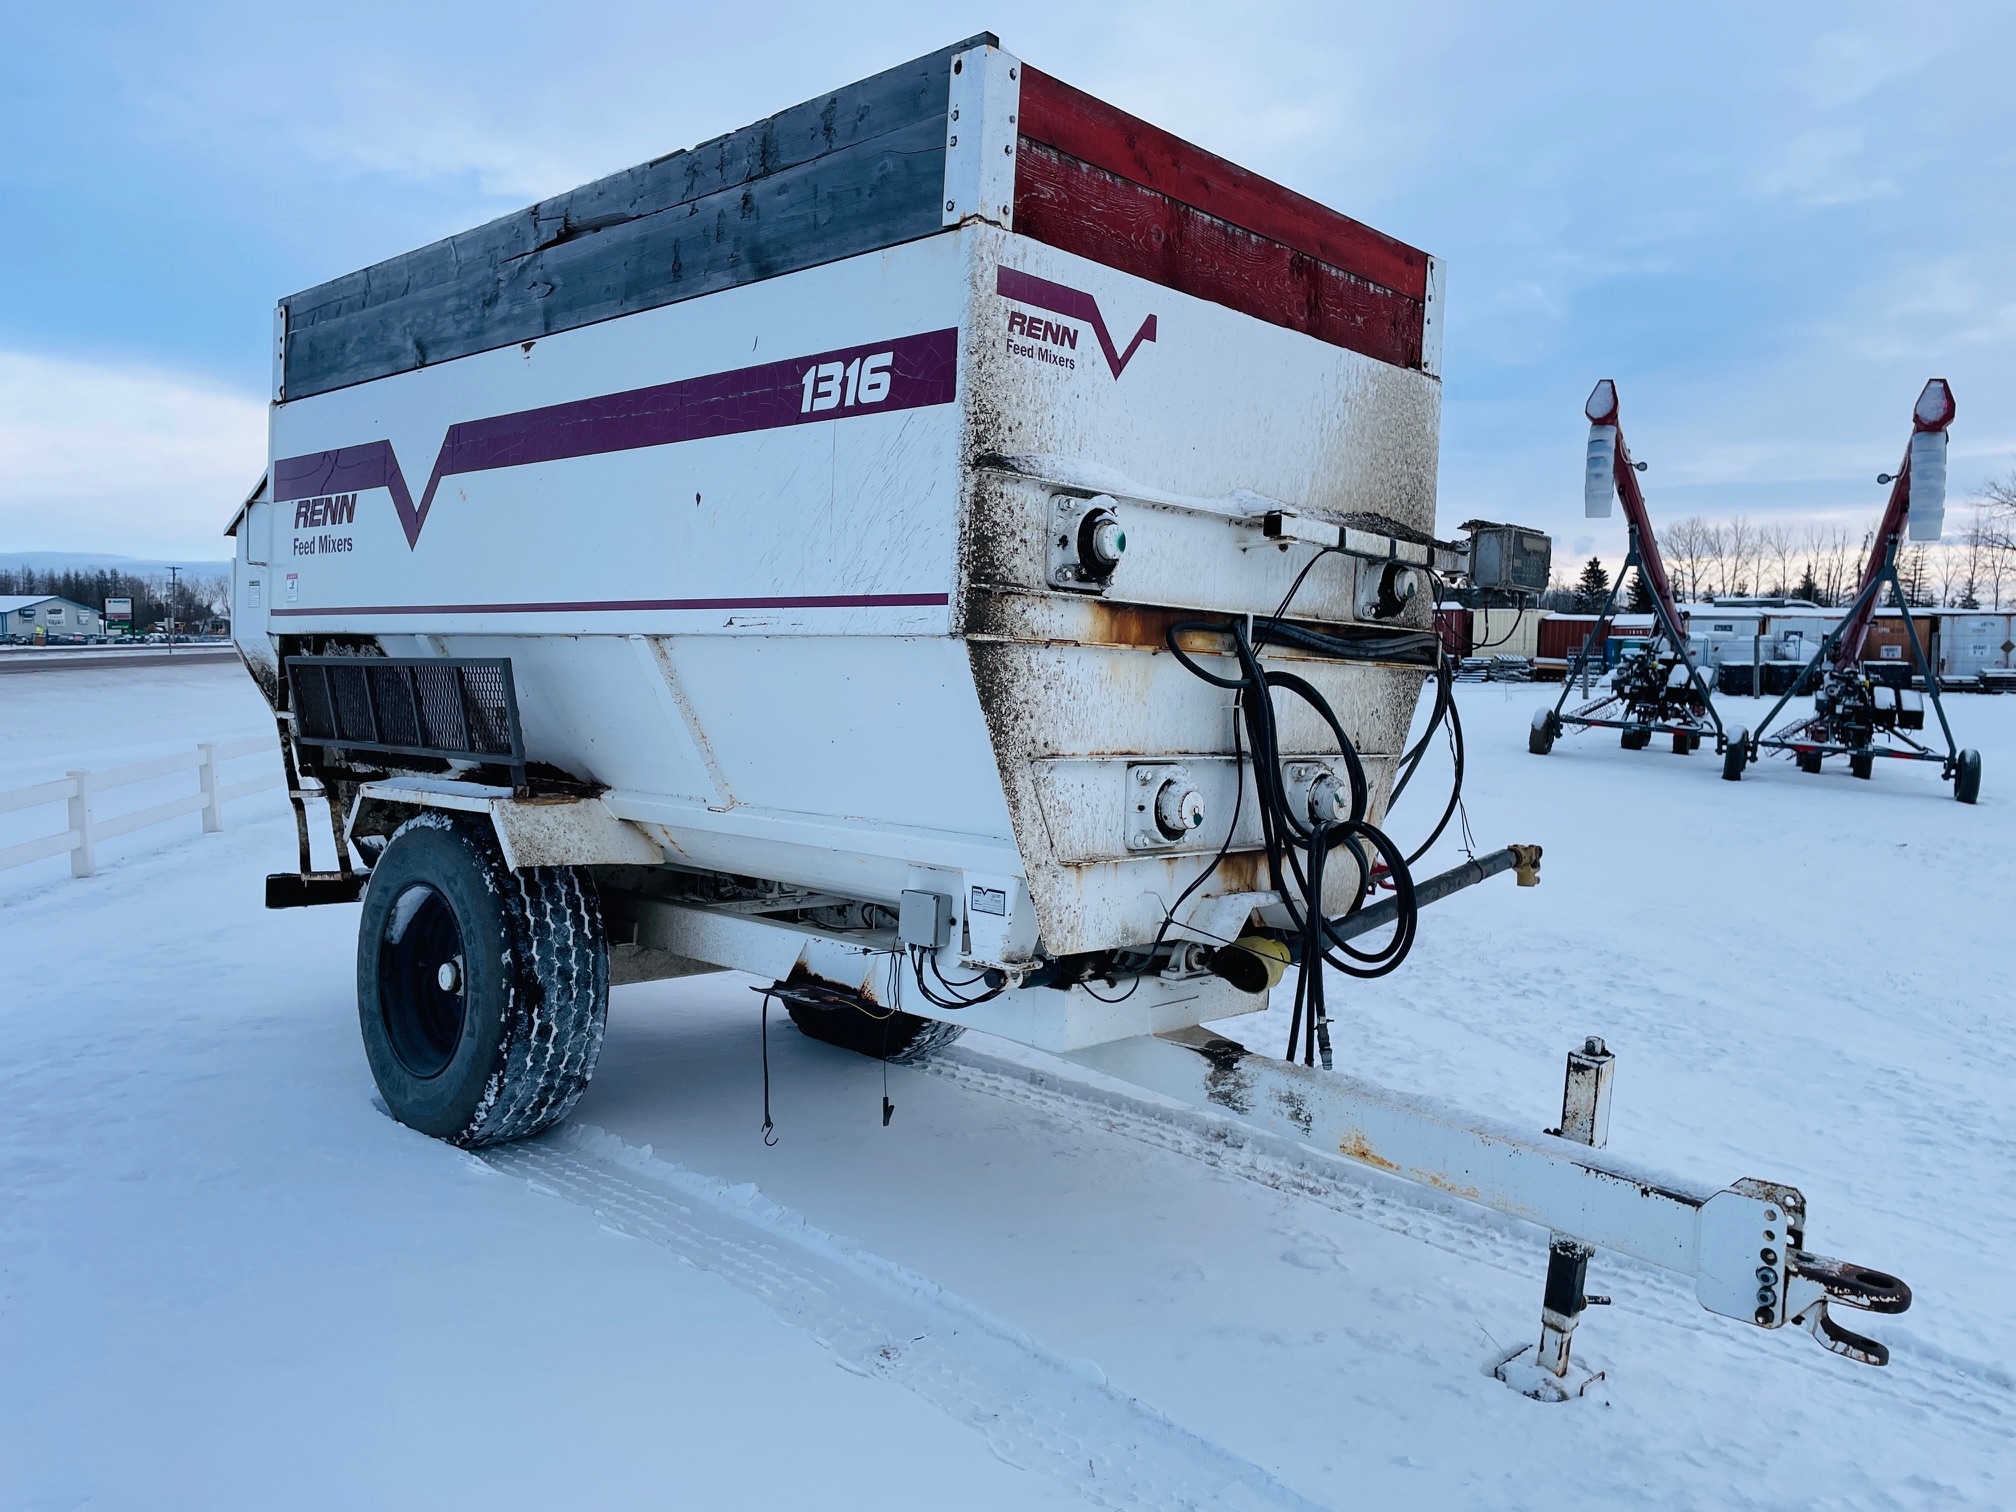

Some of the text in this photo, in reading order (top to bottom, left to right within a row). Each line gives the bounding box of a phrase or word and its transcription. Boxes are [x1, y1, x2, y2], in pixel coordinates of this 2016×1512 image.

[1007, 311, 1079, 350] RENN
[1006, 338, 1076, 371] Feed Mixers
[801, 352, 893, 413] 1316
[294, 493, 357, 529] RENN
[293, 534, 353, 556] Feed Mixers
